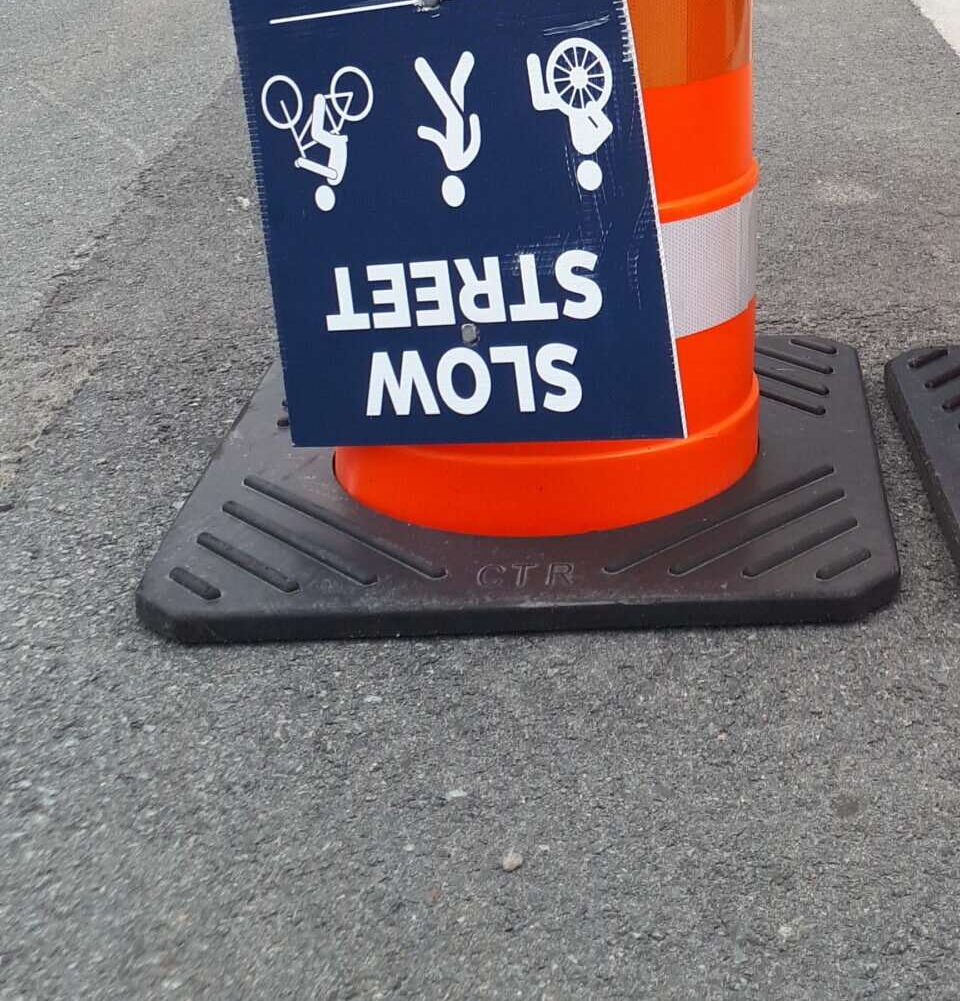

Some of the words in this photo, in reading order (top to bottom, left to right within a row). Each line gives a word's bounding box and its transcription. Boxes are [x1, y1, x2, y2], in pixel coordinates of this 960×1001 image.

[325, 248, 603, 332] STREET
[365, 342, 583, 417] SLOW
[476, 561, 575, 588] CTR
